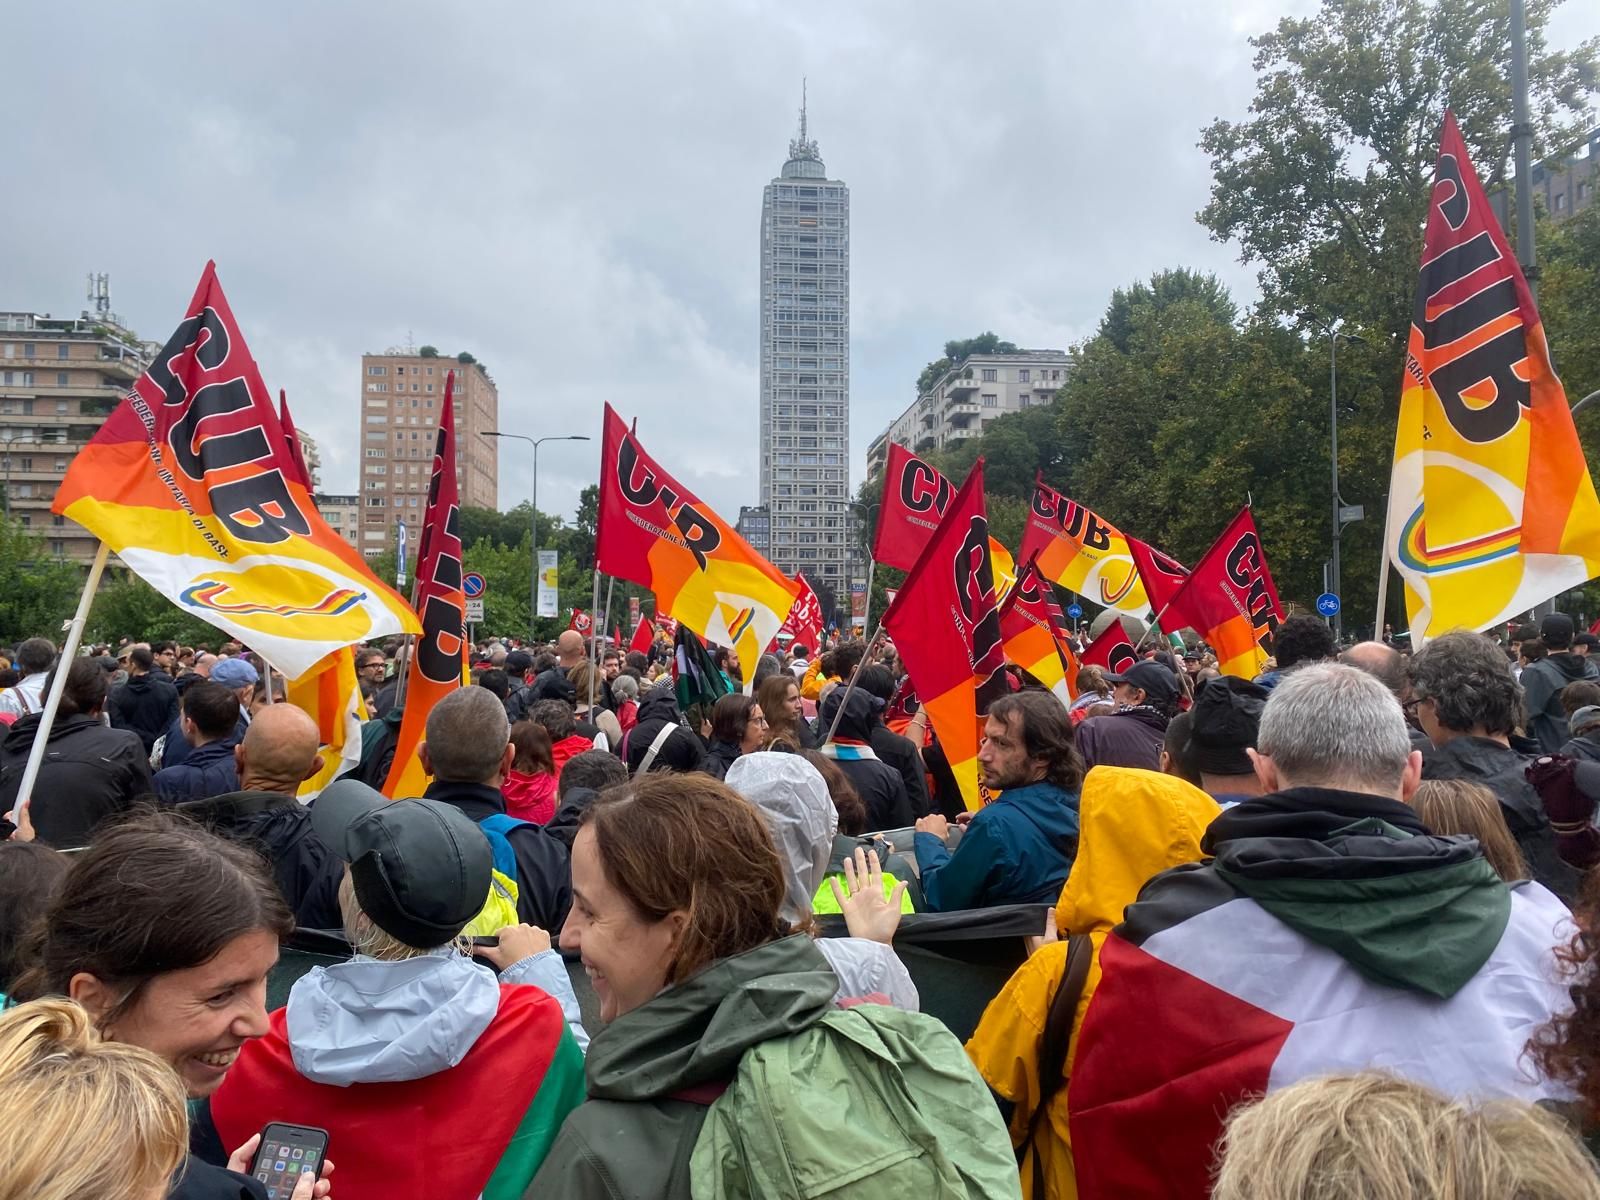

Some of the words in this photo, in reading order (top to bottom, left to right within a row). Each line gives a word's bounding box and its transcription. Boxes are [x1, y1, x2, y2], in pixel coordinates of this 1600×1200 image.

[145, 306, 312, 544] CUB
[193, 518, 206, 530] DI
[203, 531, 229, 558] BASE
